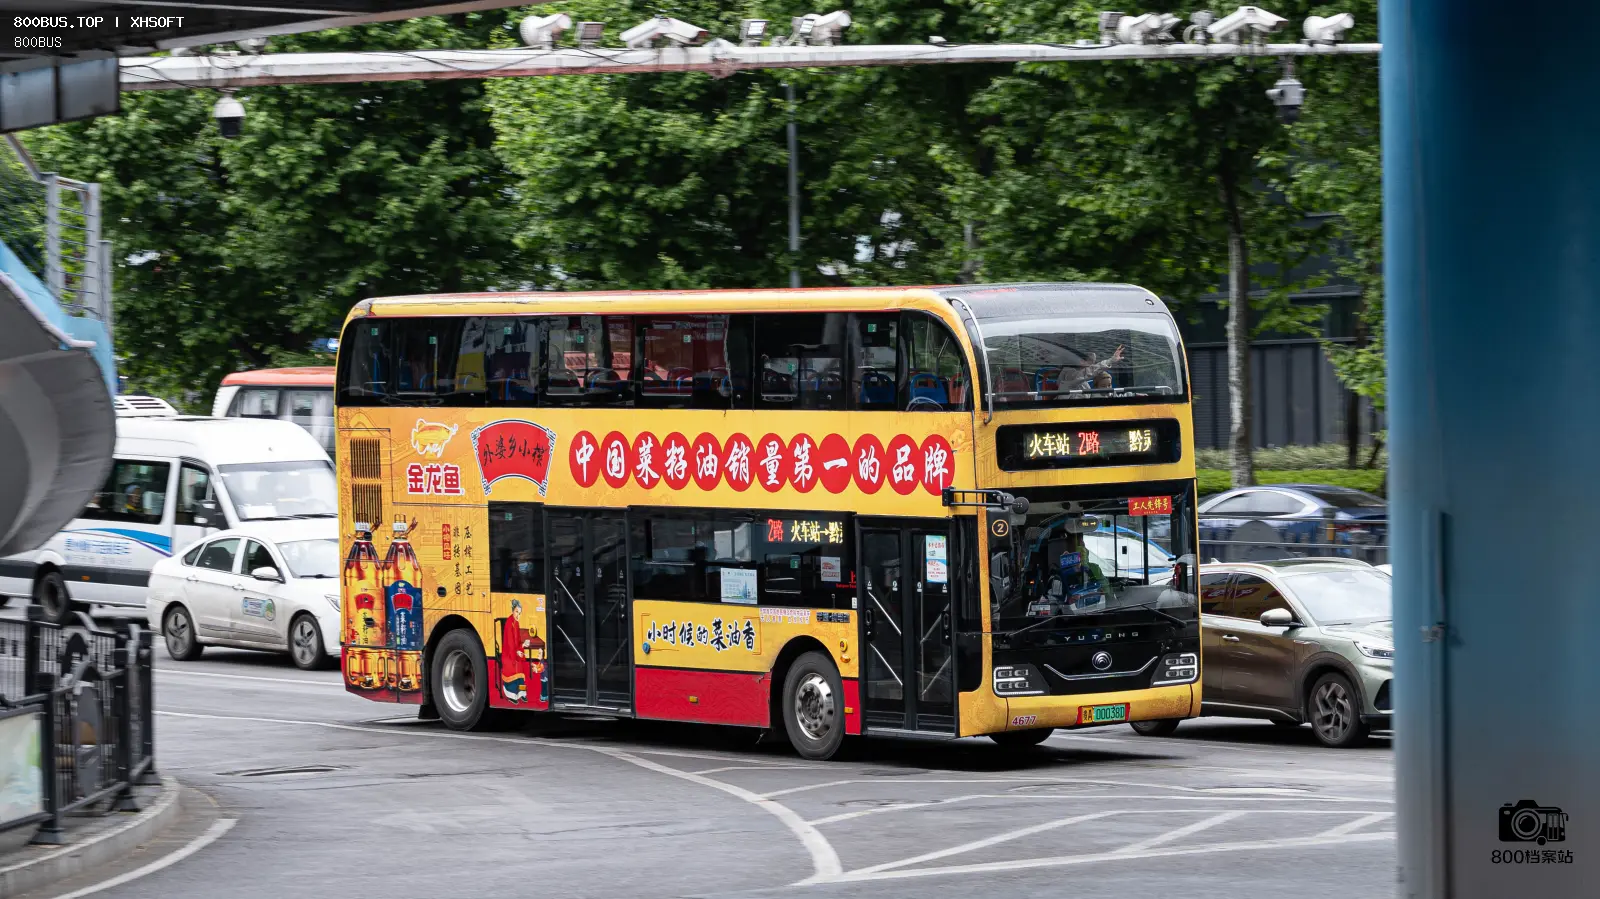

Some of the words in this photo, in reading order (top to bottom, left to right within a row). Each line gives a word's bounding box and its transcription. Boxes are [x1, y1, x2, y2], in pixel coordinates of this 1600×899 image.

[1029, 432, 1070, 457] 火车站
[1078, 431, 1100, 455] 2路
[574, 435, 951, 490] 中国菜籽油销量第一的品牌
[407, 463, 461, 494] 金龙鱼
[1132, 498, 1168, 511] 工人先锋号
[767, 518, 784, 542] 2路
[790, 520, 821, 542] 火车站
[647, 617, 756, 652] 小时候的菜油香
[1064, 632, 1139, 641] YUTONG
[1012, 715, 1037, 726] 4677
